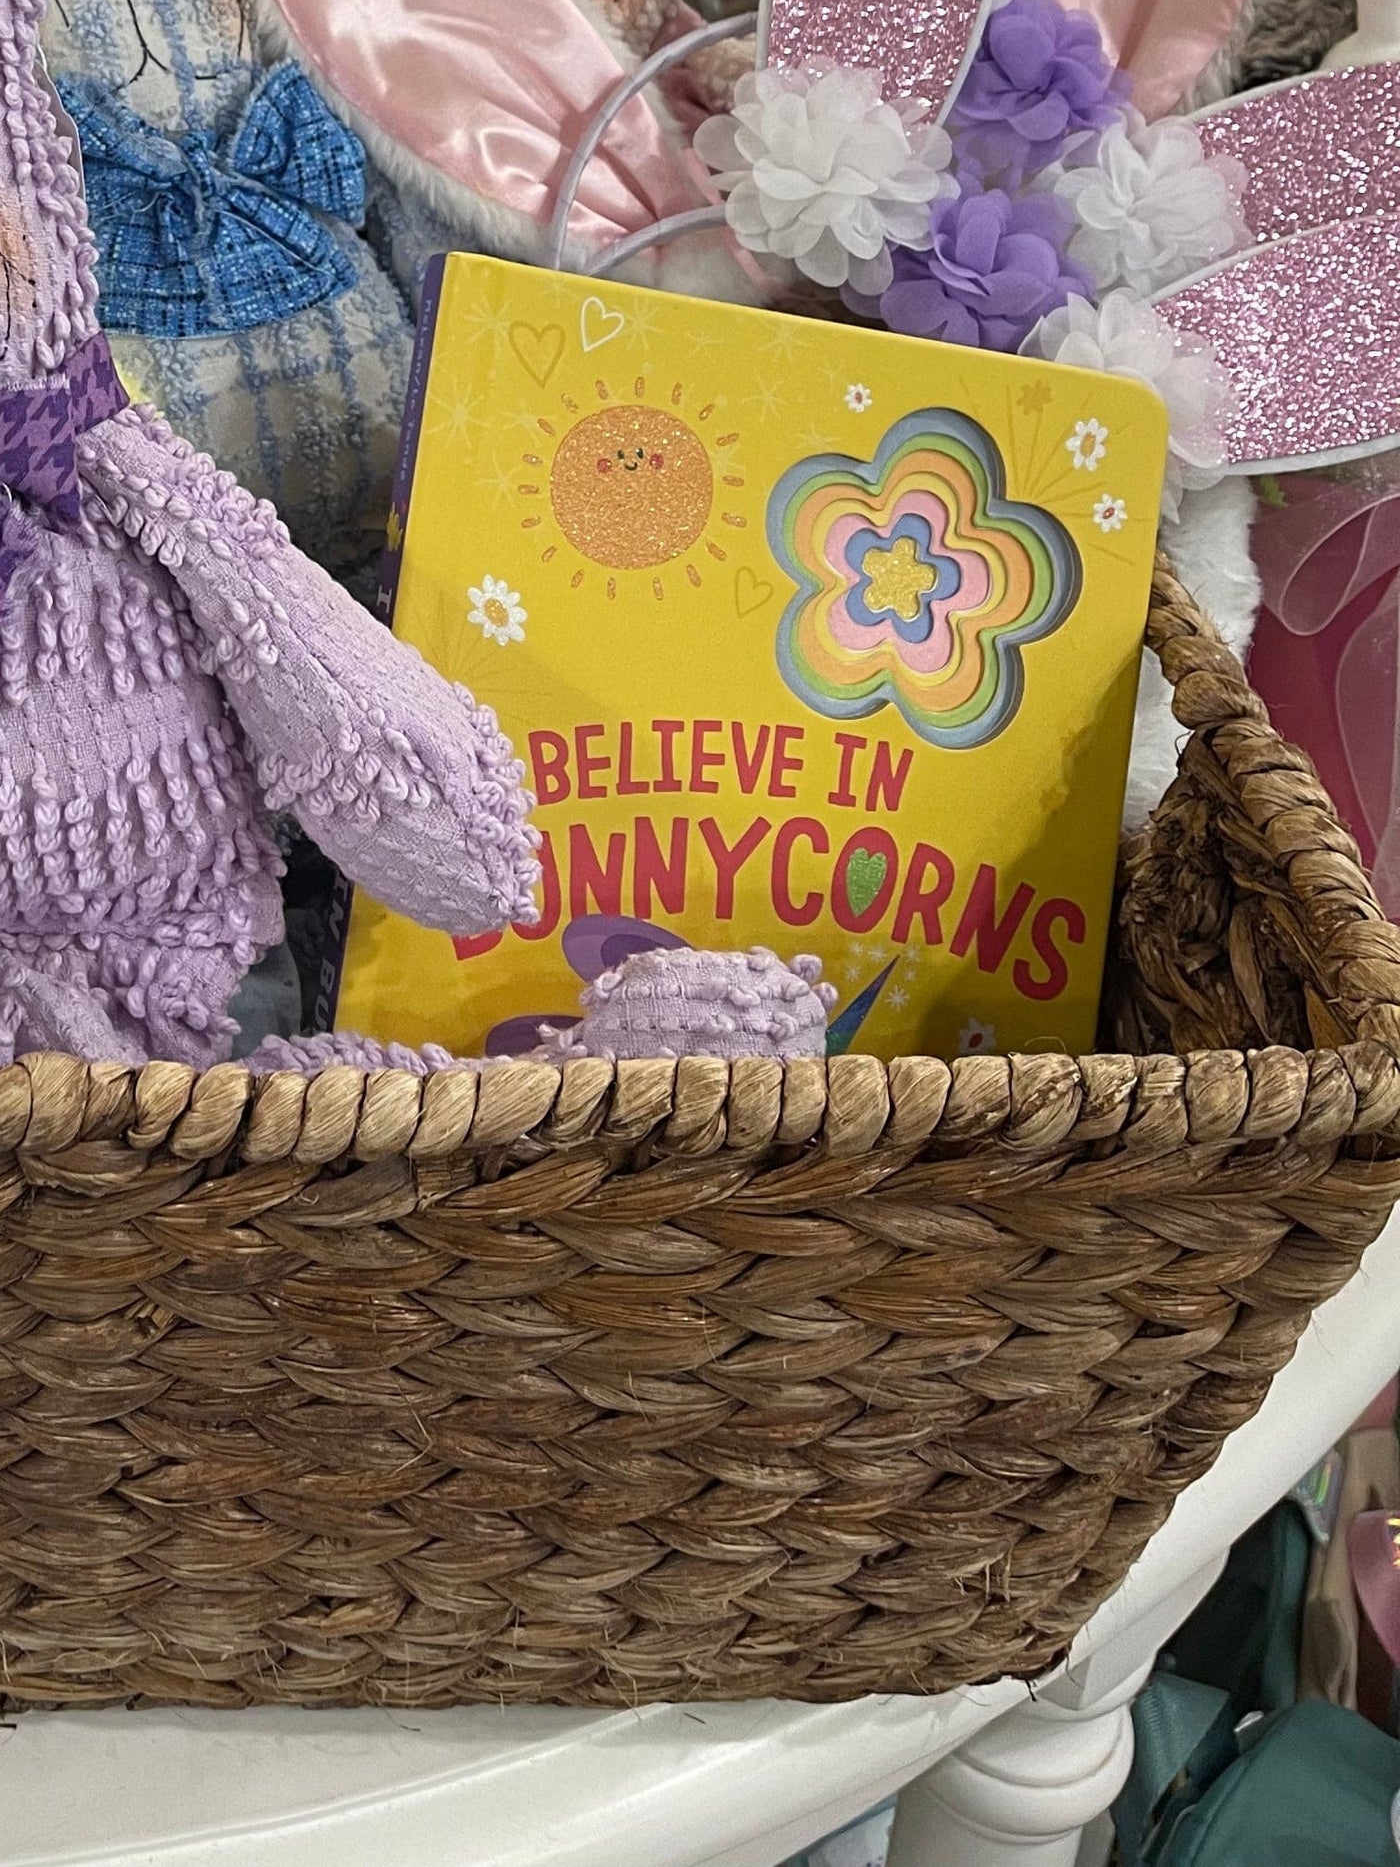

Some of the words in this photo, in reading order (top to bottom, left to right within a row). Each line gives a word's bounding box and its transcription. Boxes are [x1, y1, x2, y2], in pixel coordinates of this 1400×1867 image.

[528, 719, 805, 806] BELIEVE
[827, 732, 914, 812] IN
[451, 815, 1086, 1002] UNNYCORNS
